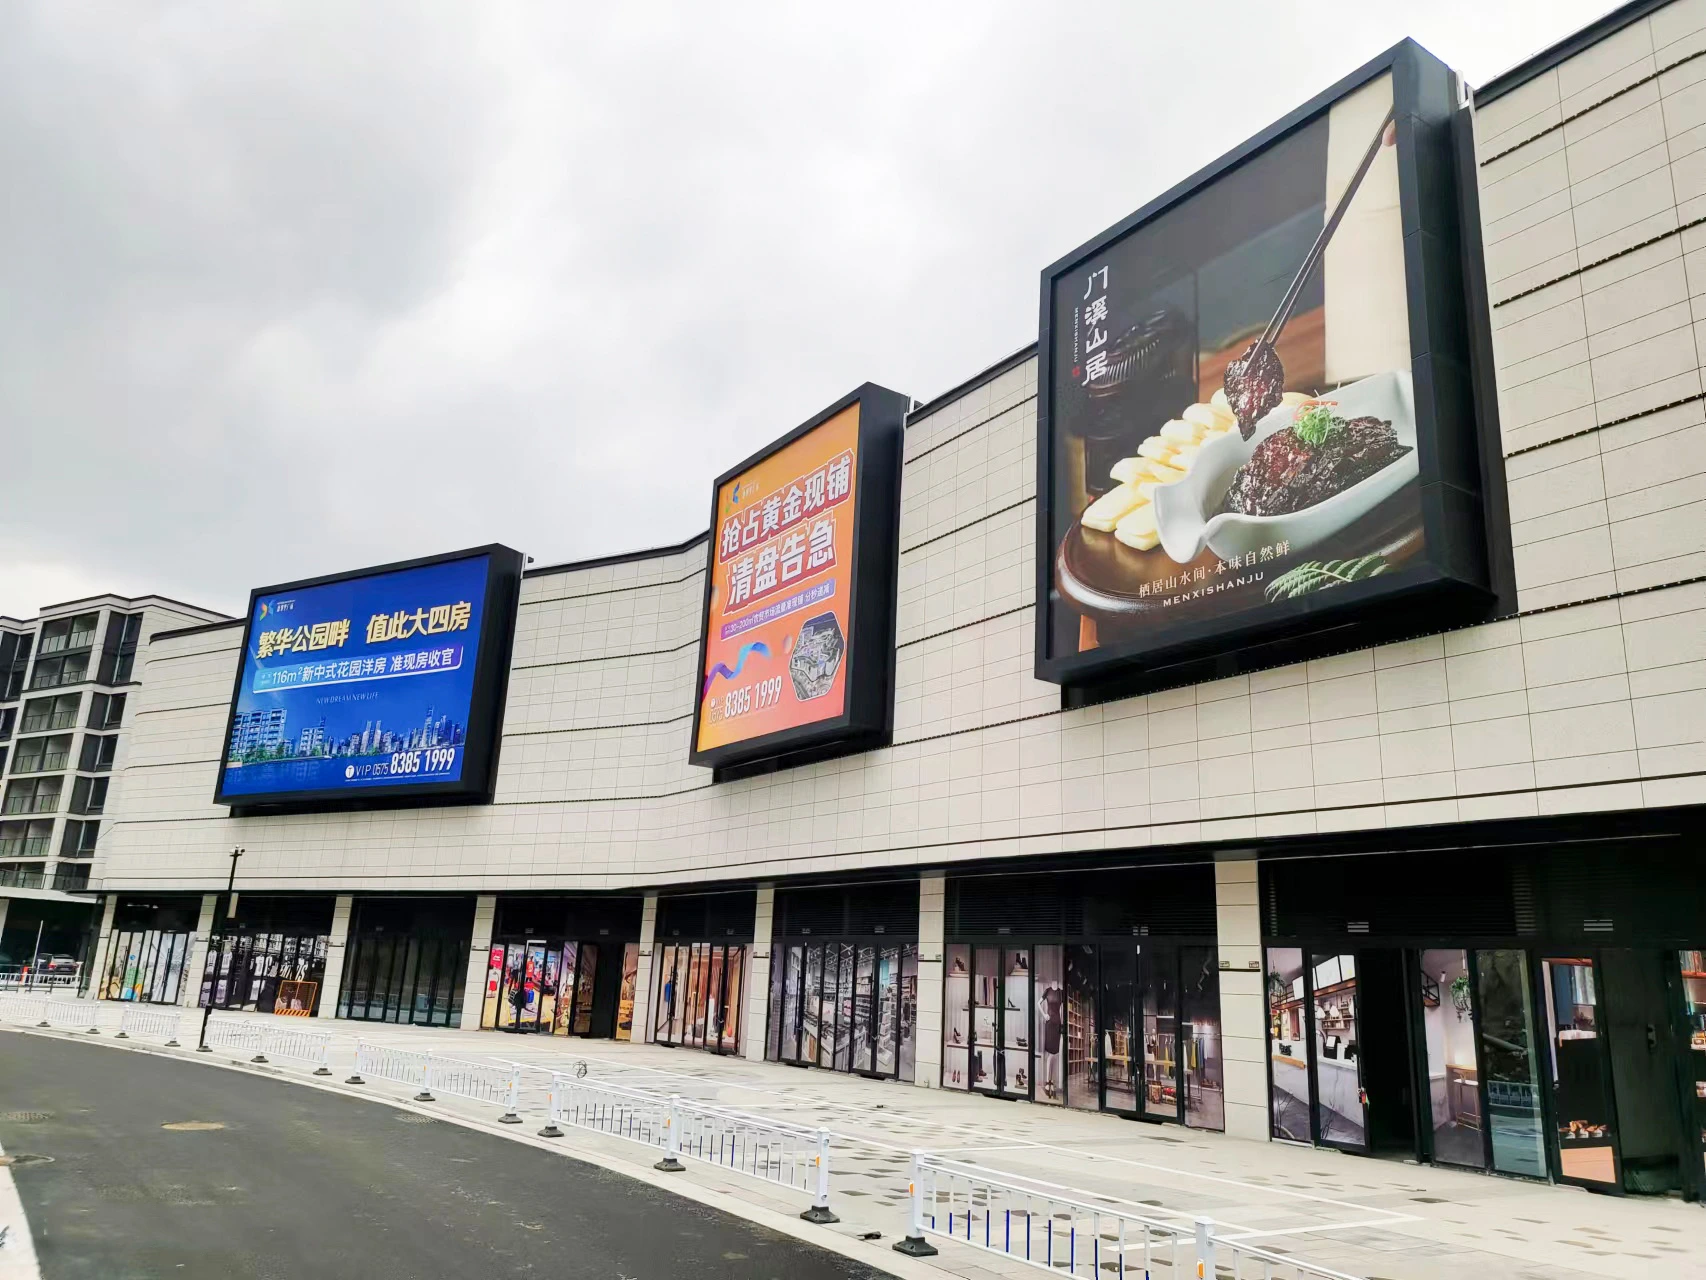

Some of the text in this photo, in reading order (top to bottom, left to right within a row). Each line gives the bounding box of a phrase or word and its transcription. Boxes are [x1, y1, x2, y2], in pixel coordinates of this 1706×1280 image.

[1082, 265, 1109, 387] 门溪山居
[721, 454, 851, 557] 抢占黄金现铺
[727, 518, 834, 606] 清盘告急
[1162, 571, 1264, 608] MENXISHANJU
[256, 600, 472, 660] 繁华公园畔 值此大四房
[390, 648, 455, 674] 准现房收官
[724, 684, 752, 718] 8385
[755, 675, 782, 710] 1999
[356, 764, 372, 777] VIP
[372, 762, 389, 776] 0575
[390, 750, 422, 774] 8385
[424, 747, 455, 771] 1999
